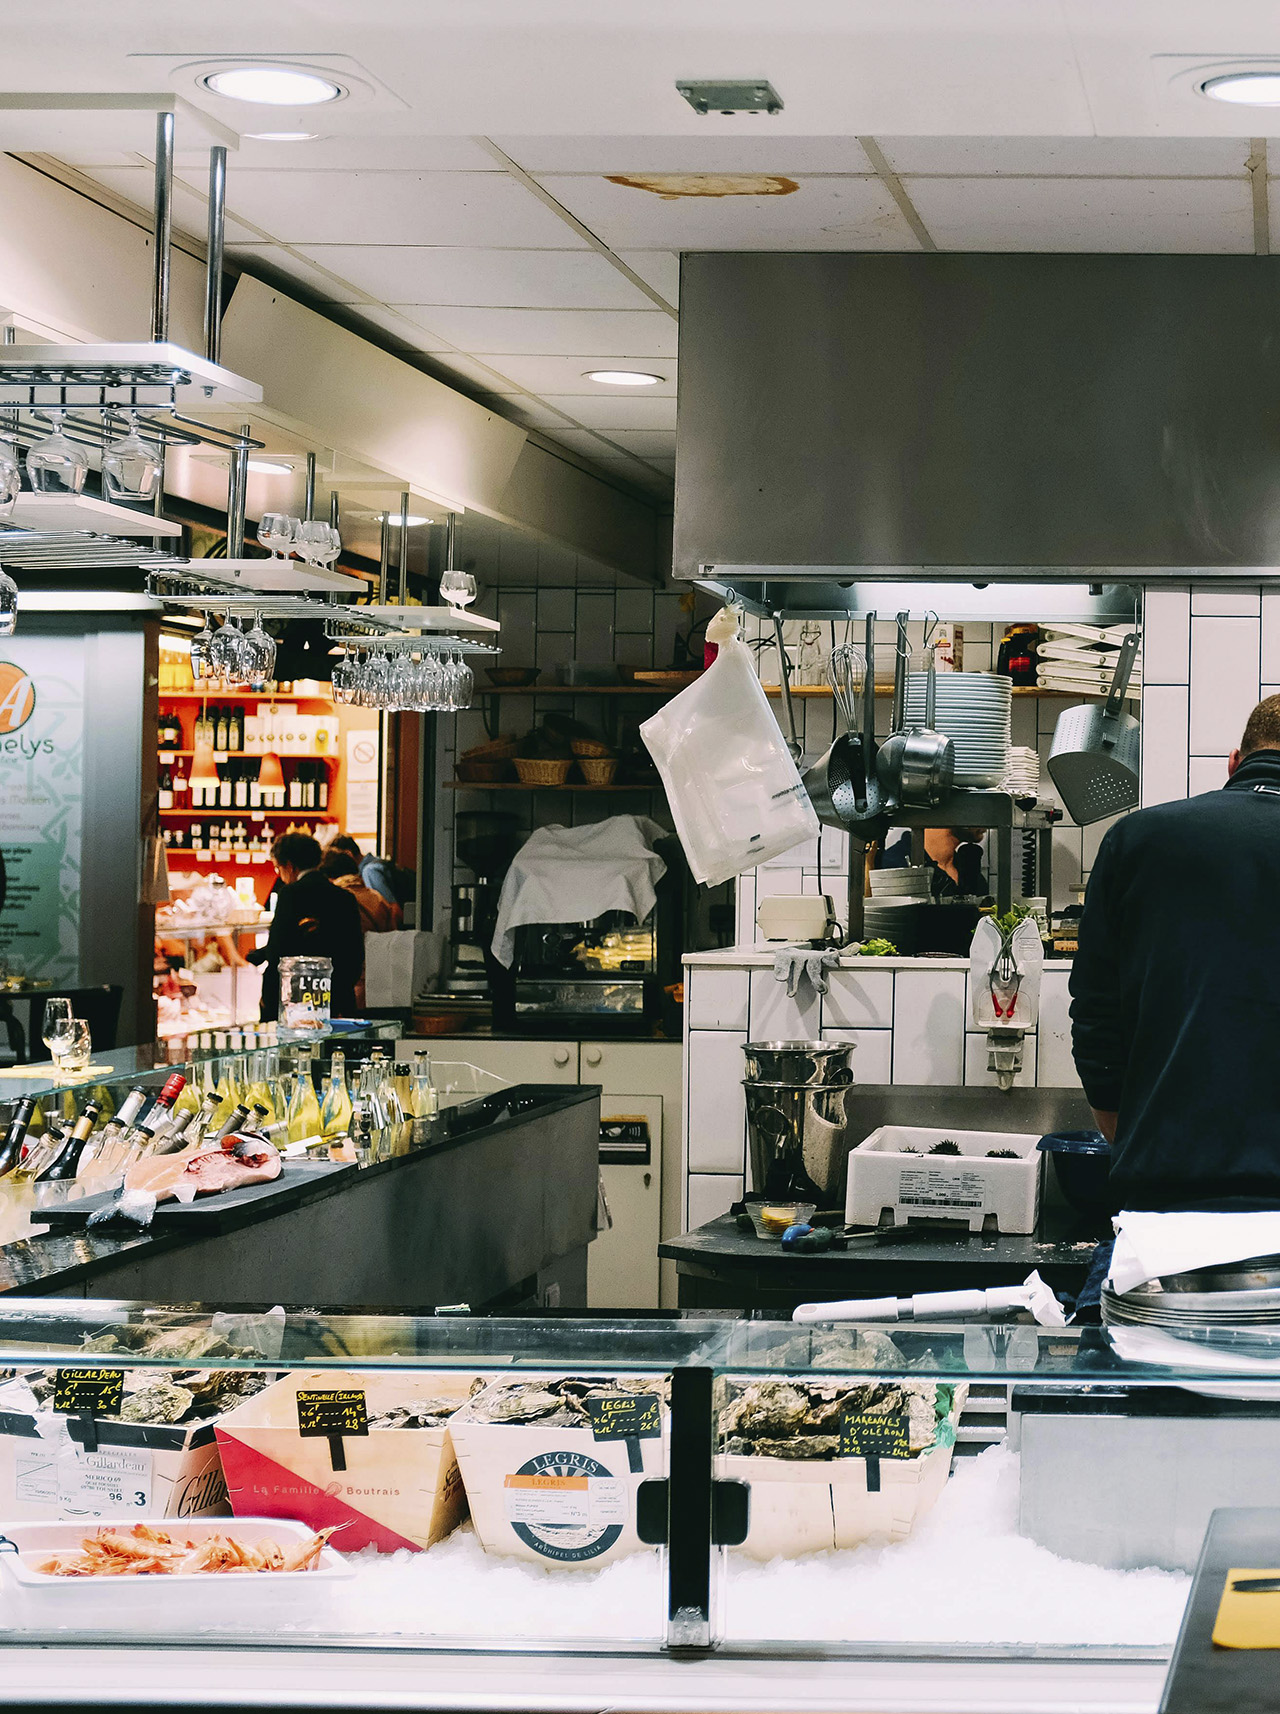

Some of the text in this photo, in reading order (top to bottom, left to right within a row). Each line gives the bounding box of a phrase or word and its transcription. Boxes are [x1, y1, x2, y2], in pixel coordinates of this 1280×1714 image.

[0, 734, 54, 760] elys
[844, 1415, 900, 1427] MARENNES
[86, 1456, 146, 1471] Gillardeau
[532, 1452, 600, 1473] LEGRIS
[253, 1485, 400, 1495] La Famille Boutrais
[532, 1478, 566, 1487] LEGRIS
[109, 1492, 123, 1501] 96
[134, 1491, 147, 1506] 3
